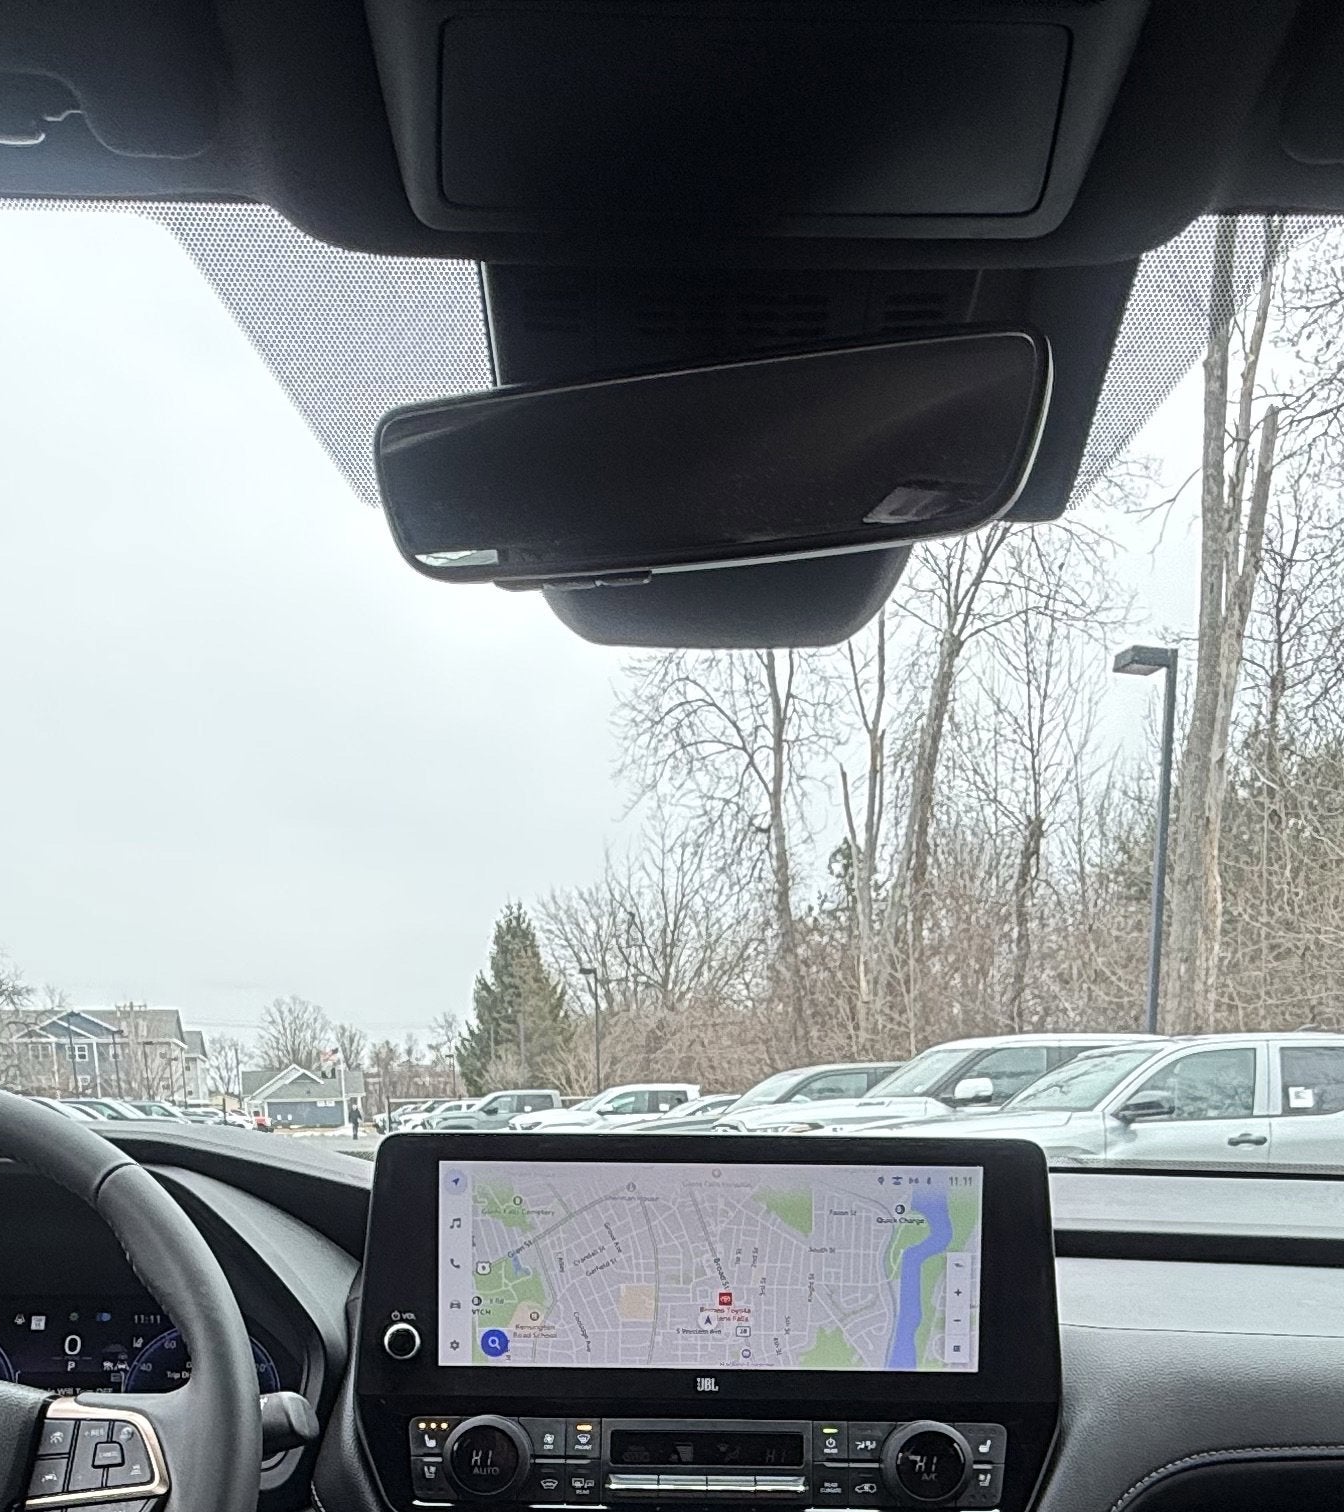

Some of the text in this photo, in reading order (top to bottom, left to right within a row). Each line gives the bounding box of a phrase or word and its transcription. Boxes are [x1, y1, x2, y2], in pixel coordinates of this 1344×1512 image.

[899, 1217, 925, 1225] Charge
[713, 1257, 727, 1281] Broad
[134, 1314, 161, 1324] 11:11
[401, 1312, 416, 1320] VOL
[164, 1340, 176, 1349] 60
[67, 1361, 76, 1371] P
[140, 1362, 153, 1371] 40
[167, 1371, 182, 1380] Trip
[697, 1377, 719, 1392] JBL
[473, 1466, 500, 1475] AUTO
[921, 1473, 938, 1481] A/C
